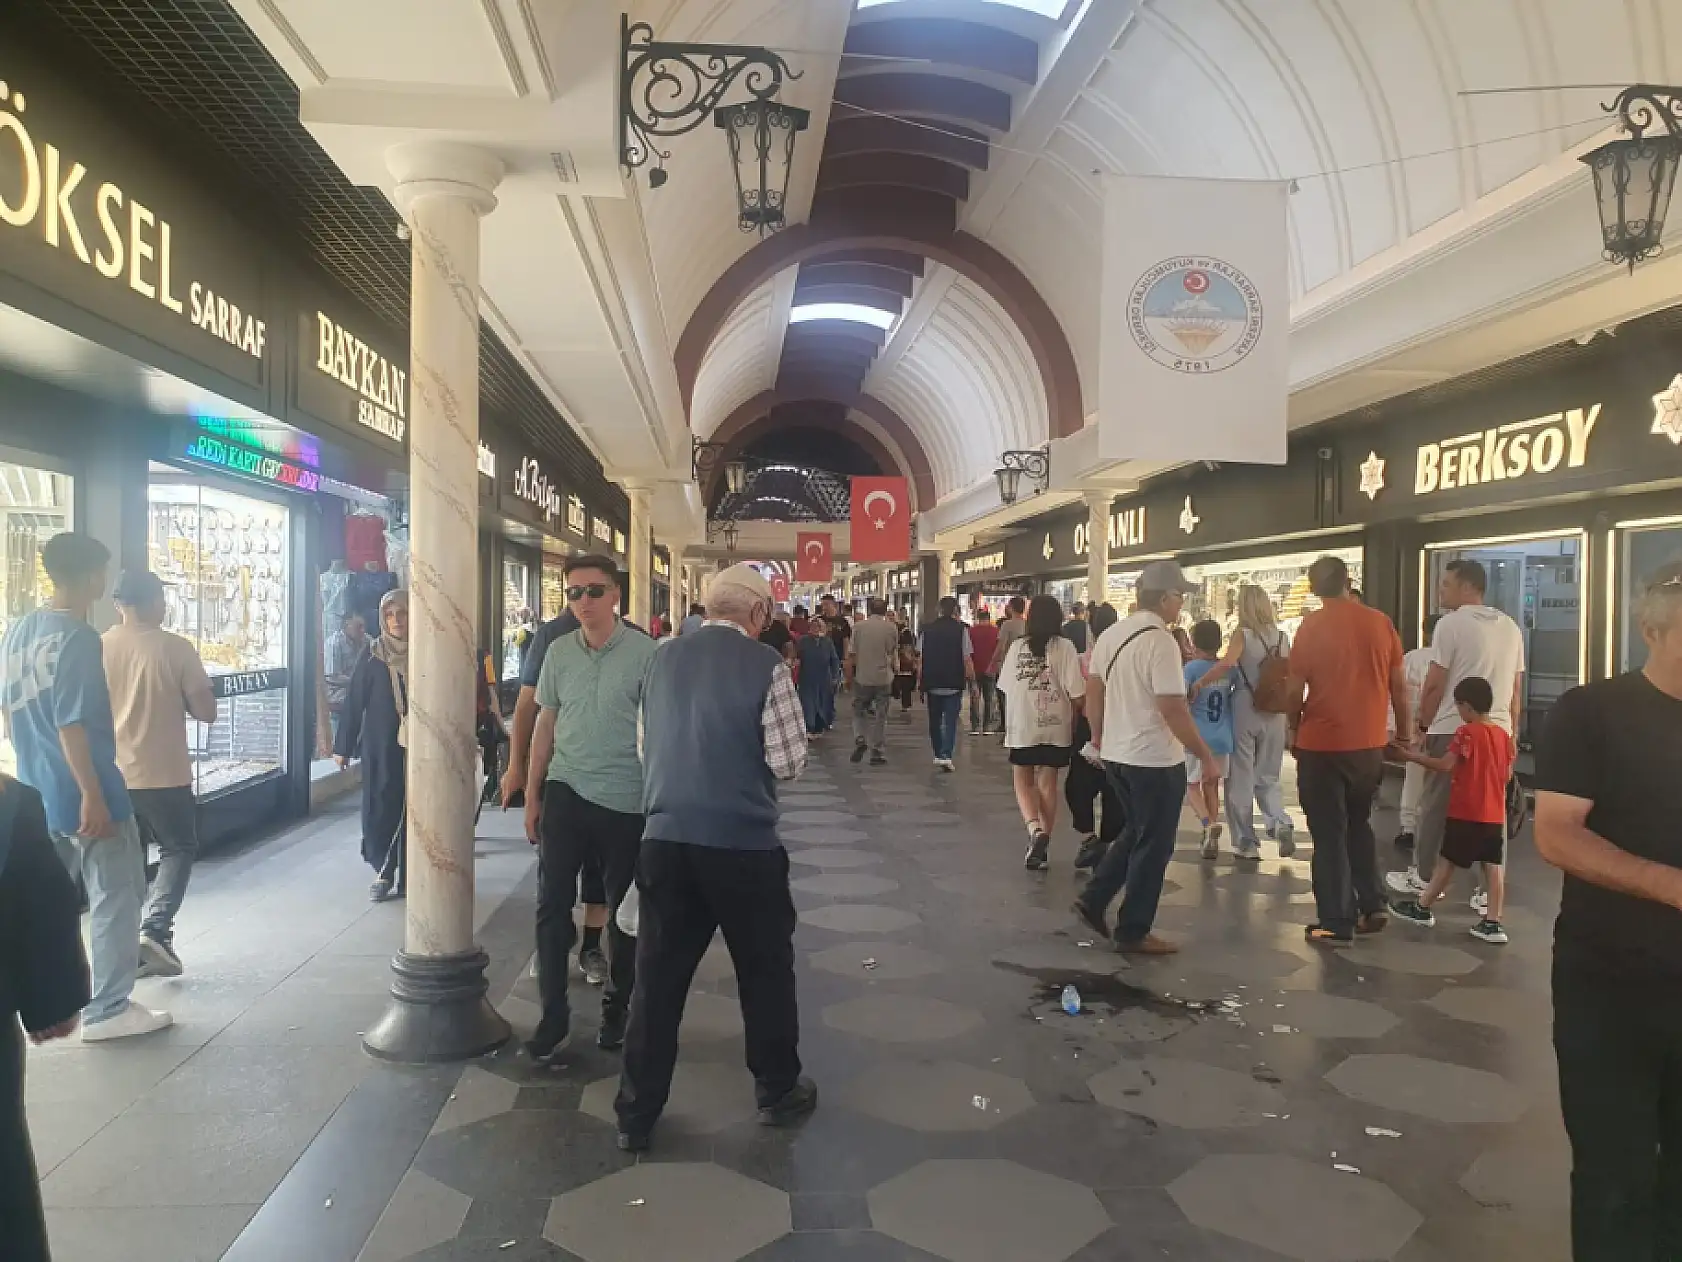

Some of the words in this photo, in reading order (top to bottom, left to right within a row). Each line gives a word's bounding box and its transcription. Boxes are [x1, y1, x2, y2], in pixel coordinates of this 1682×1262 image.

[190, 281, 266, 358] SARRAF
[316, 310, 405, 418] BAYKAN
[358, 399, 405, 442] SARRAF
[1207, 690, 1223, 723] 9
